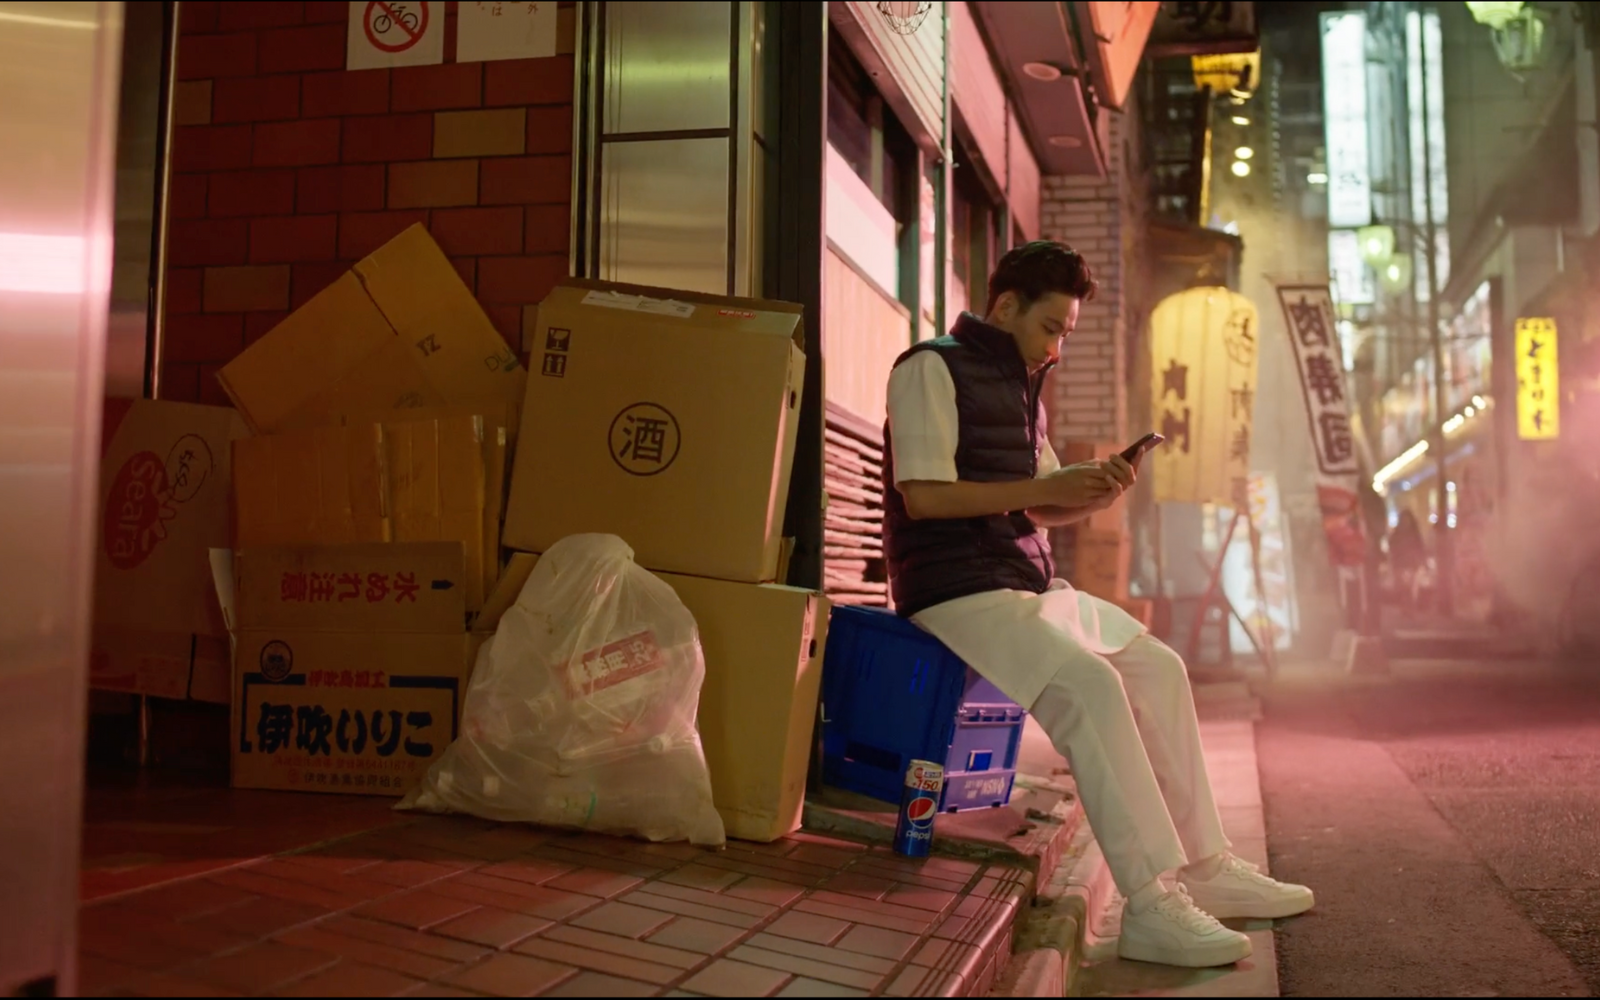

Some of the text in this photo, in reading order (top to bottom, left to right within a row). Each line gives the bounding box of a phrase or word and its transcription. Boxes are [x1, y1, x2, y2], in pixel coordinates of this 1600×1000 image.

[618, 414, 668, 463] 酒
[112, 460, 155, 558] Seara
[280, 571, 420, 604] 水ぬれ注意
[257, 701, 434, 758] 伊吹いりこ
[906, 829, 931, 841] pepsi
